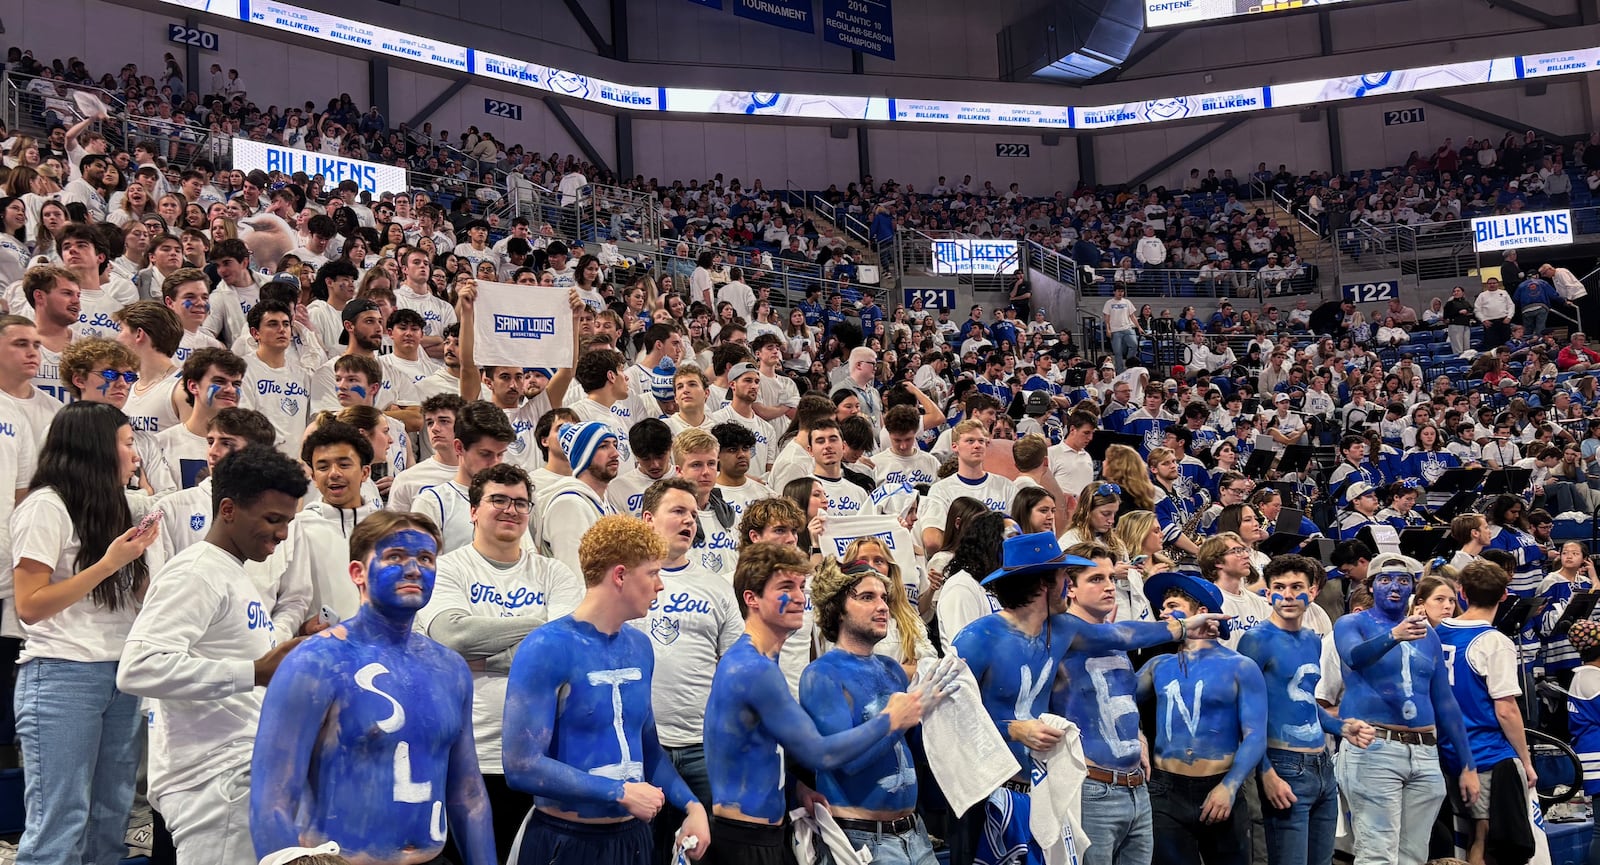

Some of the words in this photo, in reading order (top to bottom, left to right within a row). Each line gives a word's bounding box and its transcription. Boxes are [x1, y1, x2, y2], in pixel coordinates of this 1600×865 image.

[267, 6, 287, 18] SAINT
[288, 11, 308, 21] LOUIS
[741, 0, 807, 22] TOURNAMENT
[847, 1, 868, 14] 2014
[1149, 0, 1193, 12] CENTENE
[275, 17, 320, 33] BILLIKENS
[835, 9, 872, 27] ATLANTIC
[873, 21, 882, 31] 10
[172, 25, 215, 49] 220
[330, 30, 372, 46] BILLIKENS
[335, 22, 354, 33] SAINT
[354, 28, 374, 37] LOUIS
[825, 17, 892, 44] REGULAR-SEASON
[382, 42, 422, 57] BILLIKENS
[838, 33, 882, 52] CHAMPIONS
[486, 63, 539, 83] BILLIKENS
[1546, 61, 1587, 72] BILLIKENS
[600, 90, 652, 105] BILLIKENS
[1202, 97, 1257, 111] BILLIKENS
[489, 101, 520, 120] 221
[1084, 111, 1136, 124] BILLIKENS
[1389, 109, 1421, 125] 201
[998, 144, 1028, 157] 222
[1475, 212, 1569, 243] BILLIKENS
[1499, 236, 1548, 247] BASKETBALL
[912, 289, 948, 308] 121
[1350, 281, 1392, 303] 122
[496, 316, 525, 332] SAINT
[527, 319, 554, 333] LOUIS
[257, 379, 282, 396] The
[886, 470, 909, 485] The
[911, 469, 933, 484] Lou
[837, 497, 860, 511] Lou
[708, 531, 738, 550] Lou
[470, 582, 503, 605] The
[663, 592, 711, 614] Lou
[1084, 655, 1141, 759] E
[1163, 678, 1204, 743] N
[1281, 663, 1323, 743] S
[134, 829, 151, 844] N
